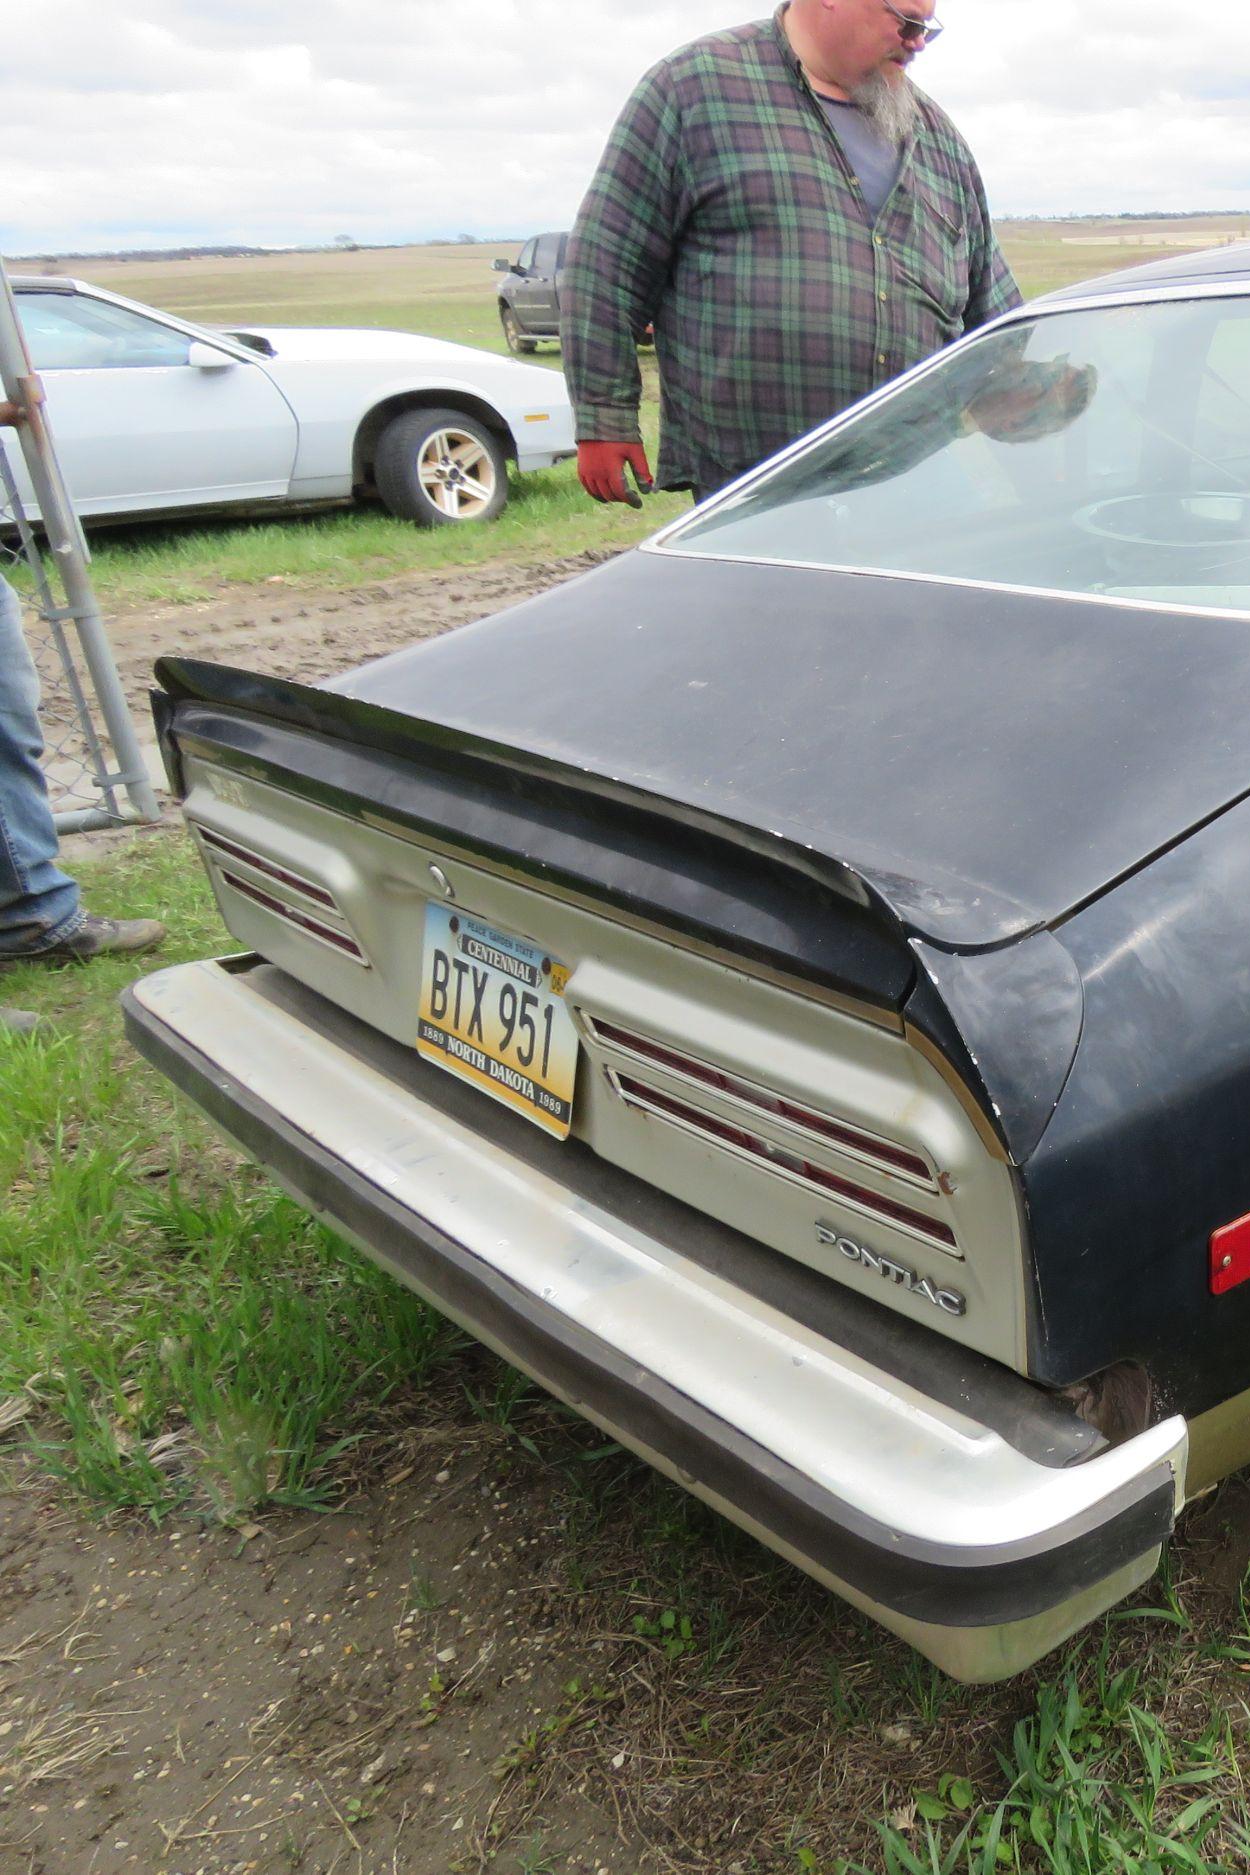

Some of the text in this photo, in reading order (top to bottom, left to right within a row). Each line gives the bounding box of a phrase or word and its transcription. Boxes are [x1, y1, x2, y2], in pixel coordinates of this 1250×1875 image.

[467, 921, 535, 959] PEACE GARDEN STATE
[467, 939, 532, 983] CENTENNIAL
[430, 949, 554, 1078] BTX 951
[423, 1026, 562, 1115] 1889 NORTH DAKOTA 1989
[815, 1220, 966, 1317] PONTIAC
